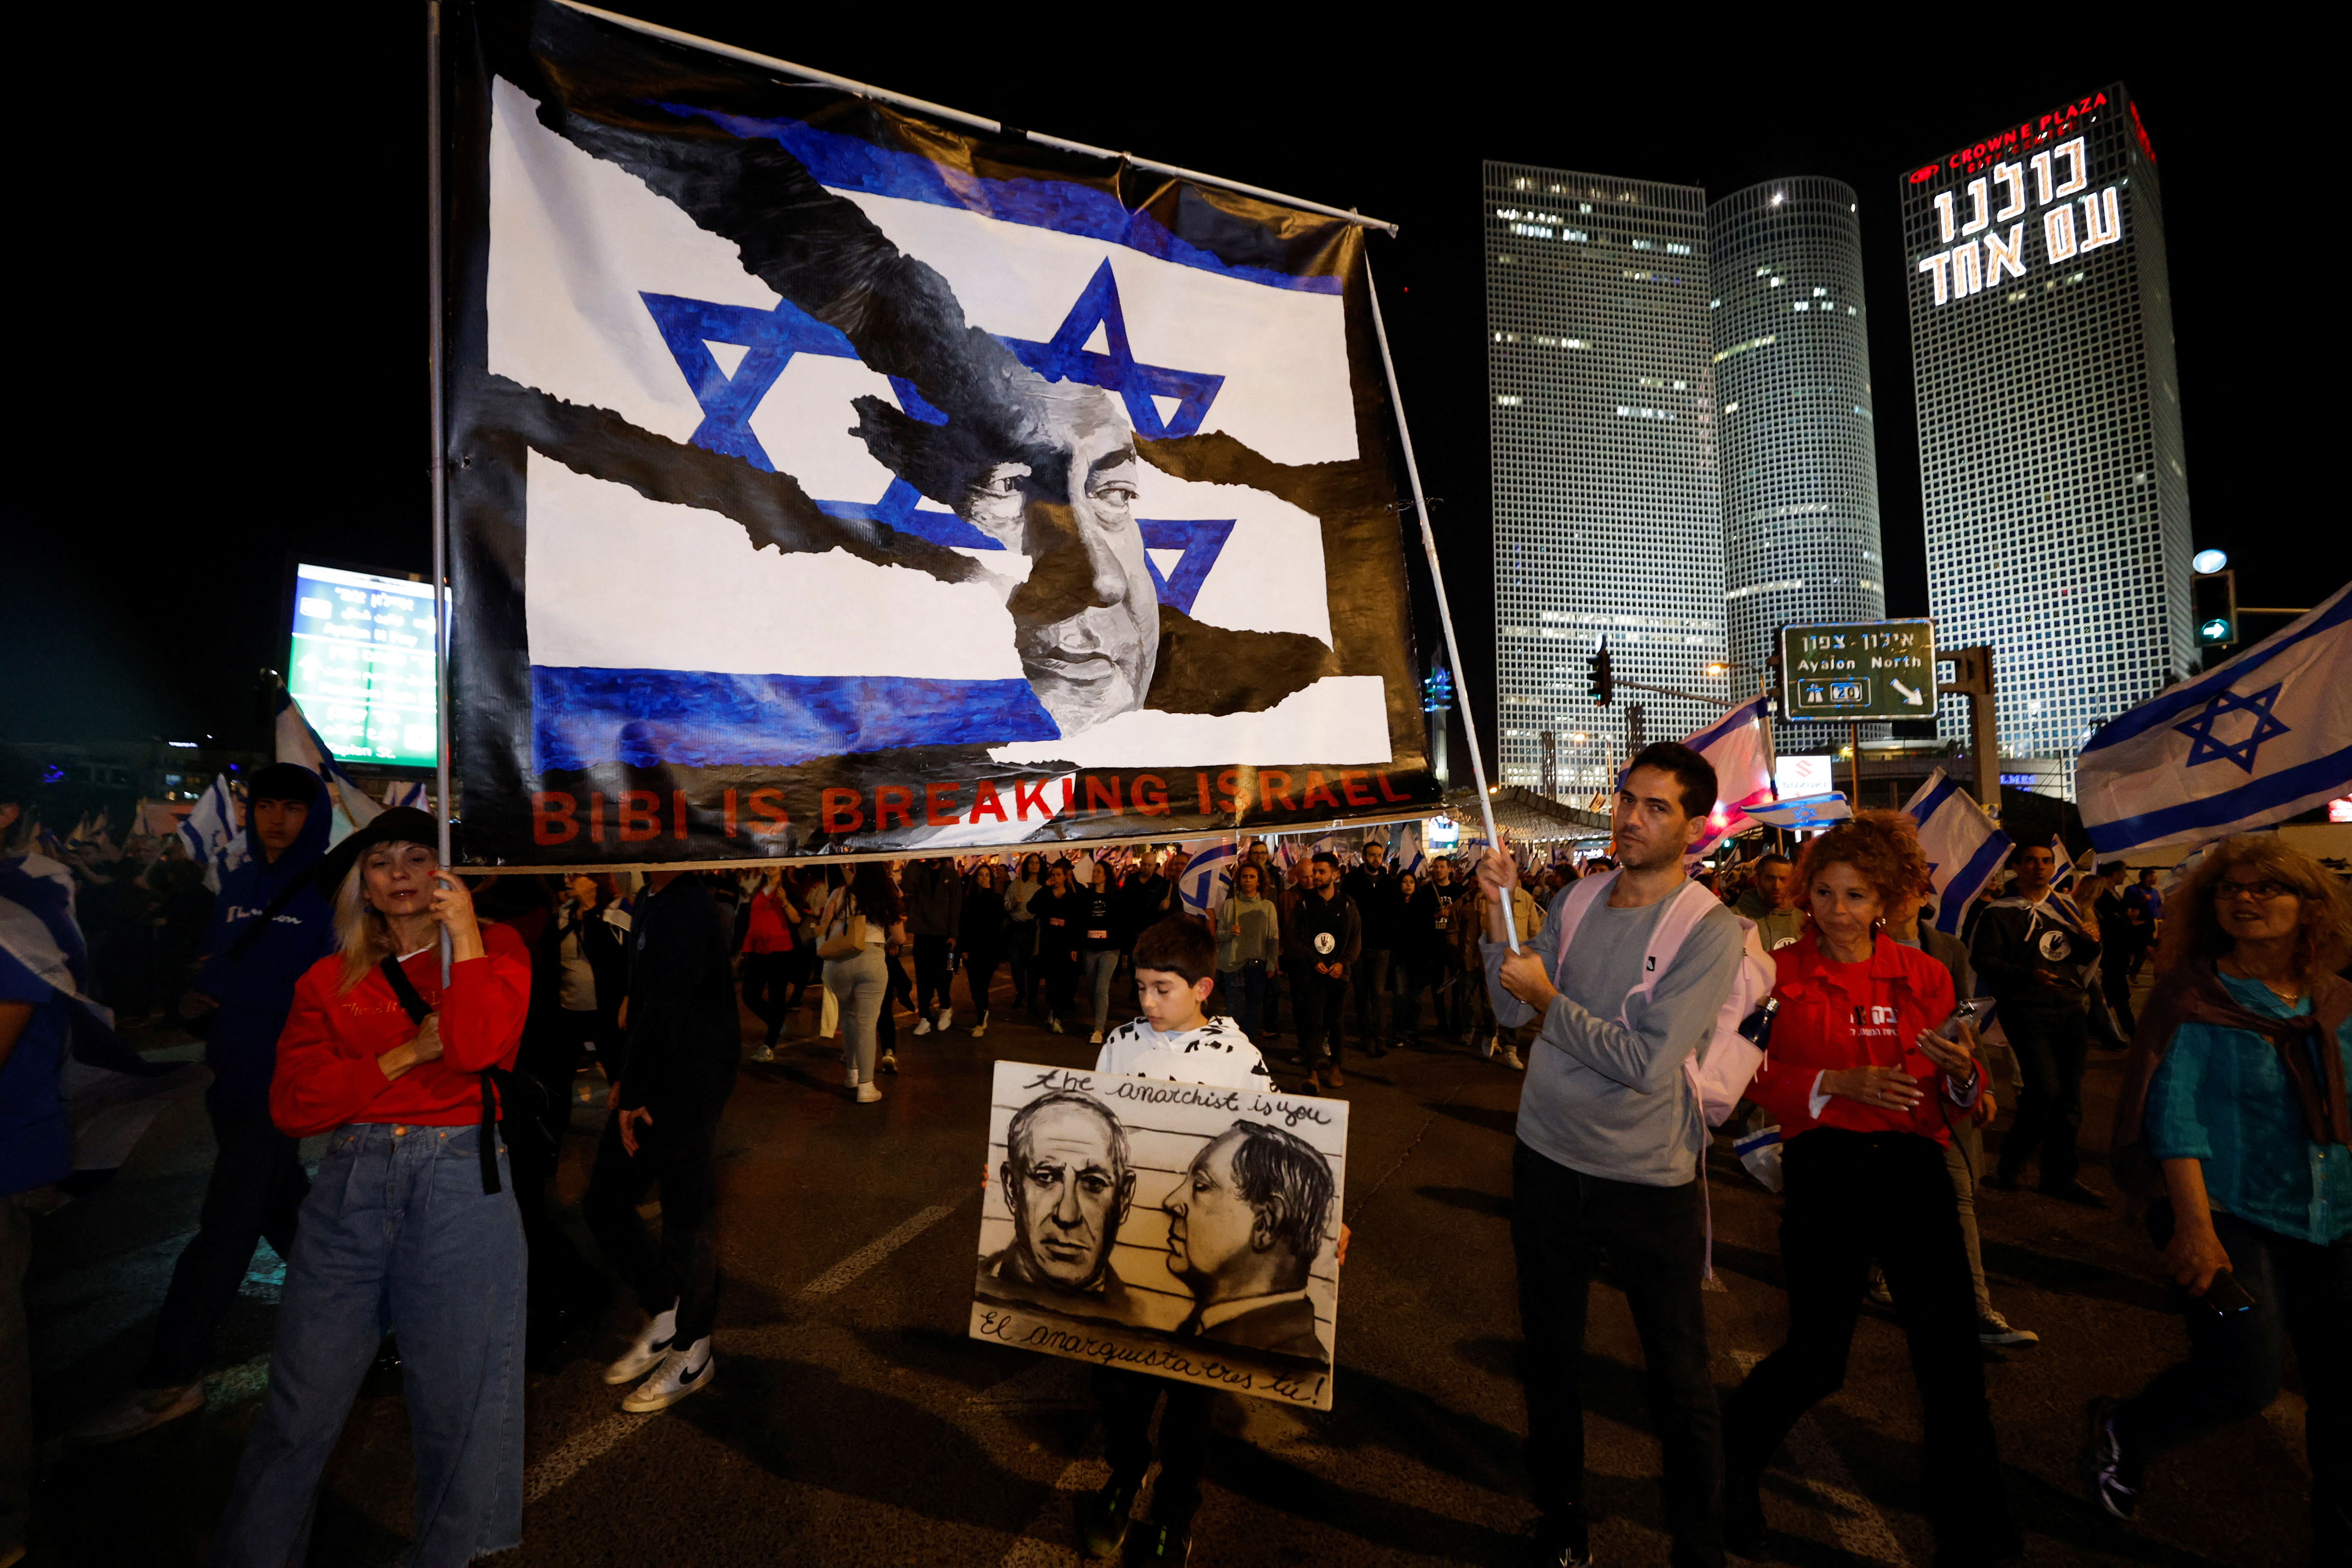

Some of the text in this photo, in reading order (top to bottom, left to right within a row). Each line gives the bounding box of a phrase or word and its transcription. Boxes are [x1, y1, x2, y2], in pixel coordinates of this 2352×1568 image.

[1949, 92, 2107, 169] CROWNE PLAZA
[1934, 136, 2087, 244] כולנו
[1919, 186, 2121, 306] עם אחד
[1797, 655, 1921, 673] Ayalon North
[1802, 632, 1915, 653] אילון צפון
[531, 768, 1412, 846] BIBI IS BREAKING ISRAEL
[1022, 1070, 1331, 1127] the anarchist is you
[981, 1311, 1013, 1341] El
[1020, 1326, 1201, 1376] anarquista
